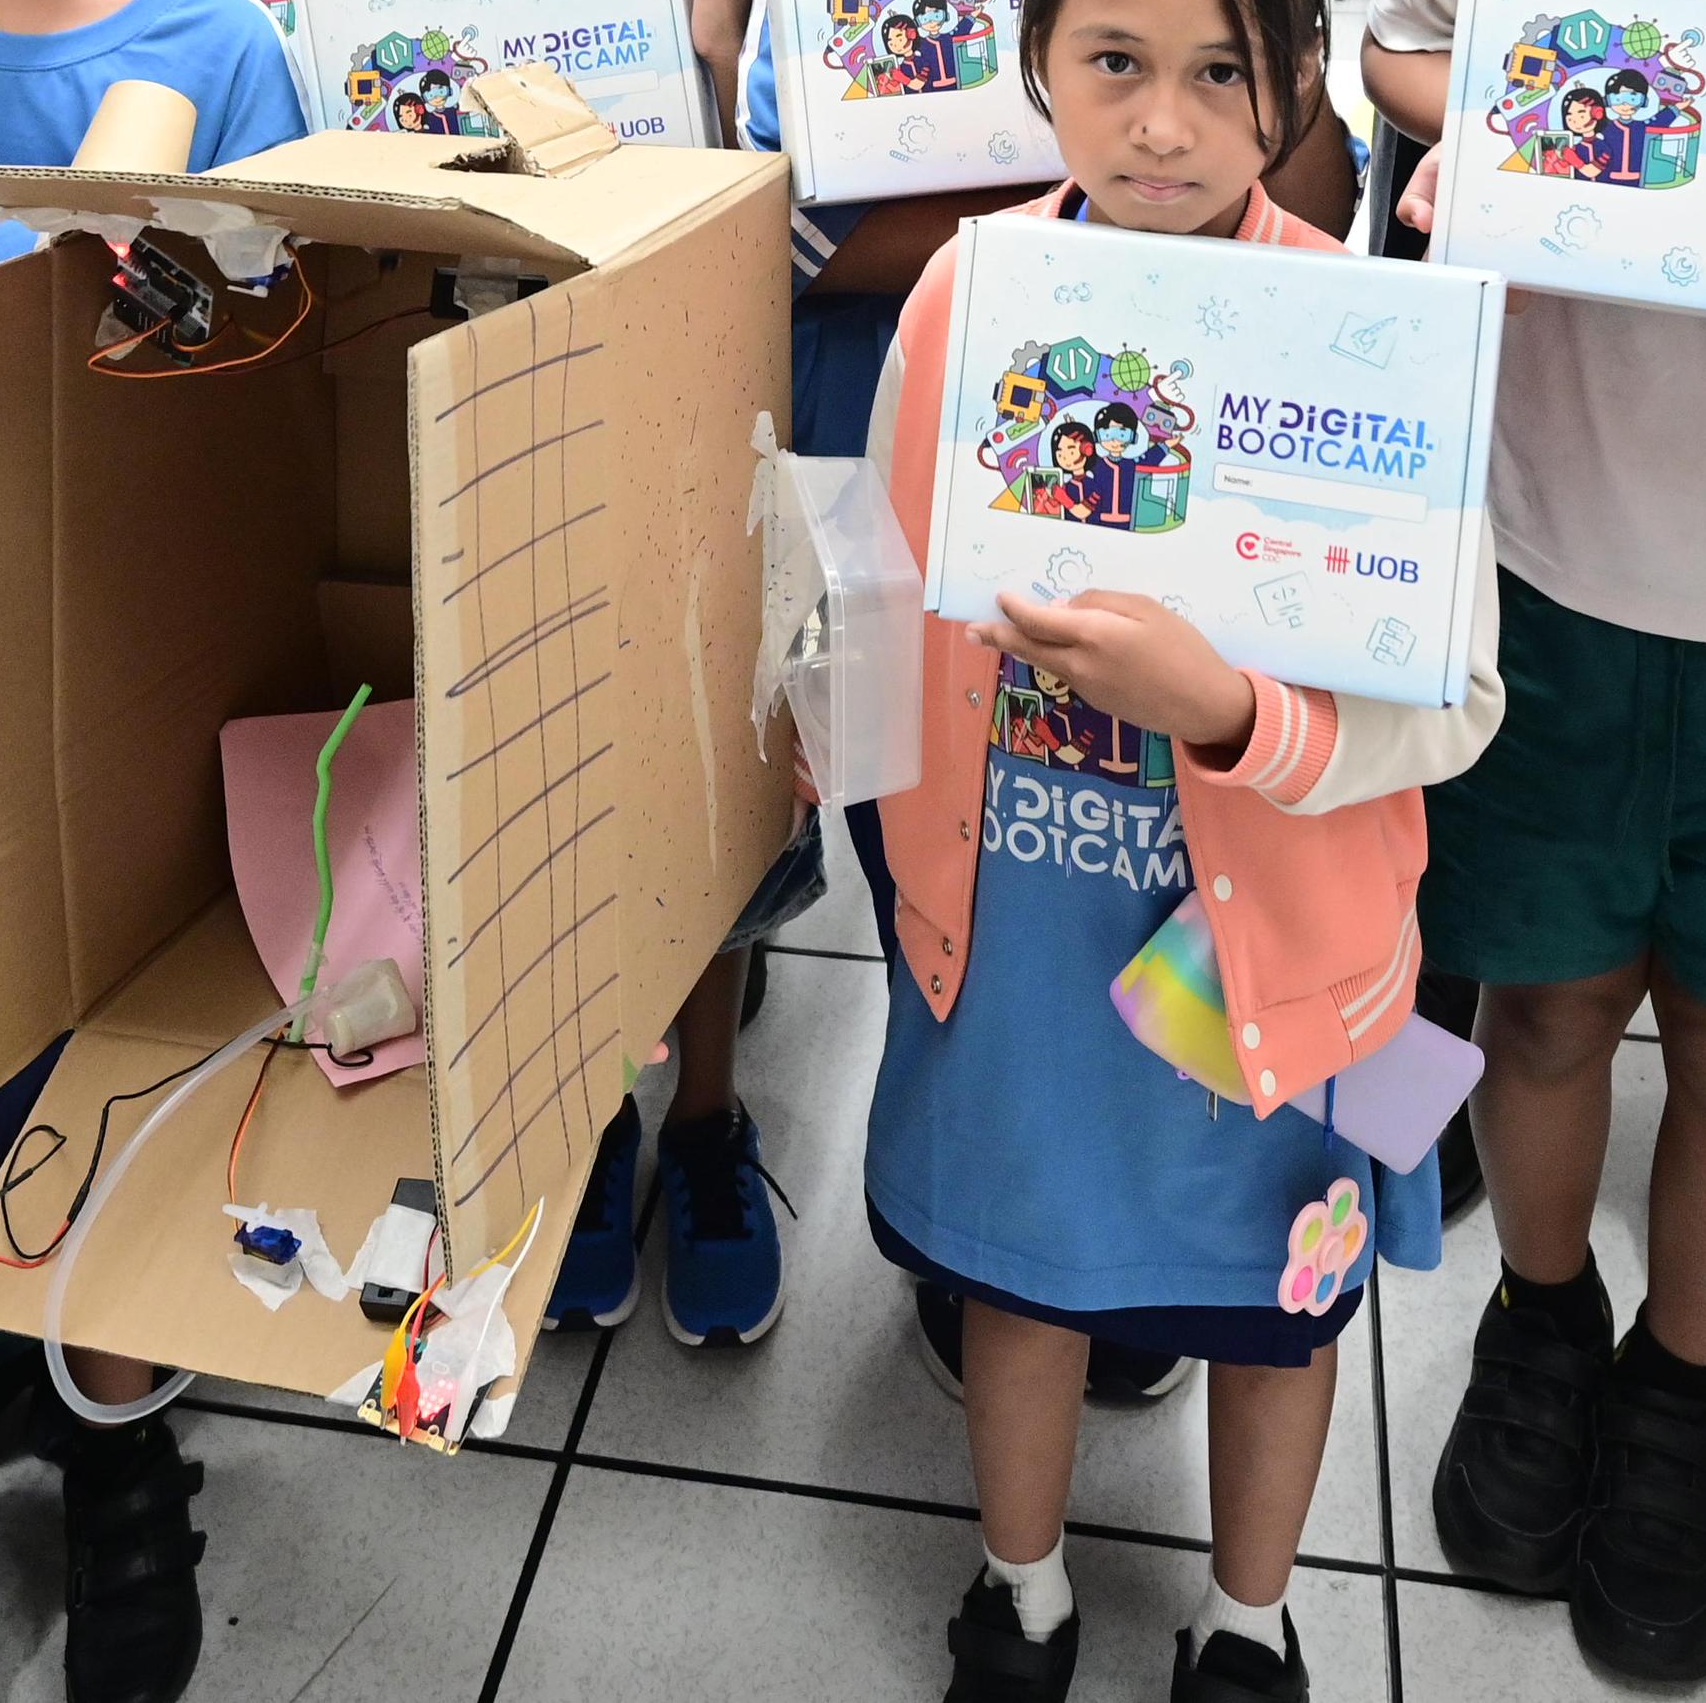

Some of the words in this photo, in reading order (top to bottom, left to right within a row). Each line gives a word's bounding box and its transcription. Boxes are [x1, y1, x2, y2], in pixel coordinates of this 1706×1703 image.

[504, 35, 536, 59] MY
[620, 117, 665, 138] UOB
[1220, 393, 1271, 424] MY
[1216, 424, 1427, 479] BOOTCAMP
[1223, 474, 1253, 487] Name:
[1355, 552, 1419, 583] UOB
[983, 807, 1187, 892] OOTCAM
